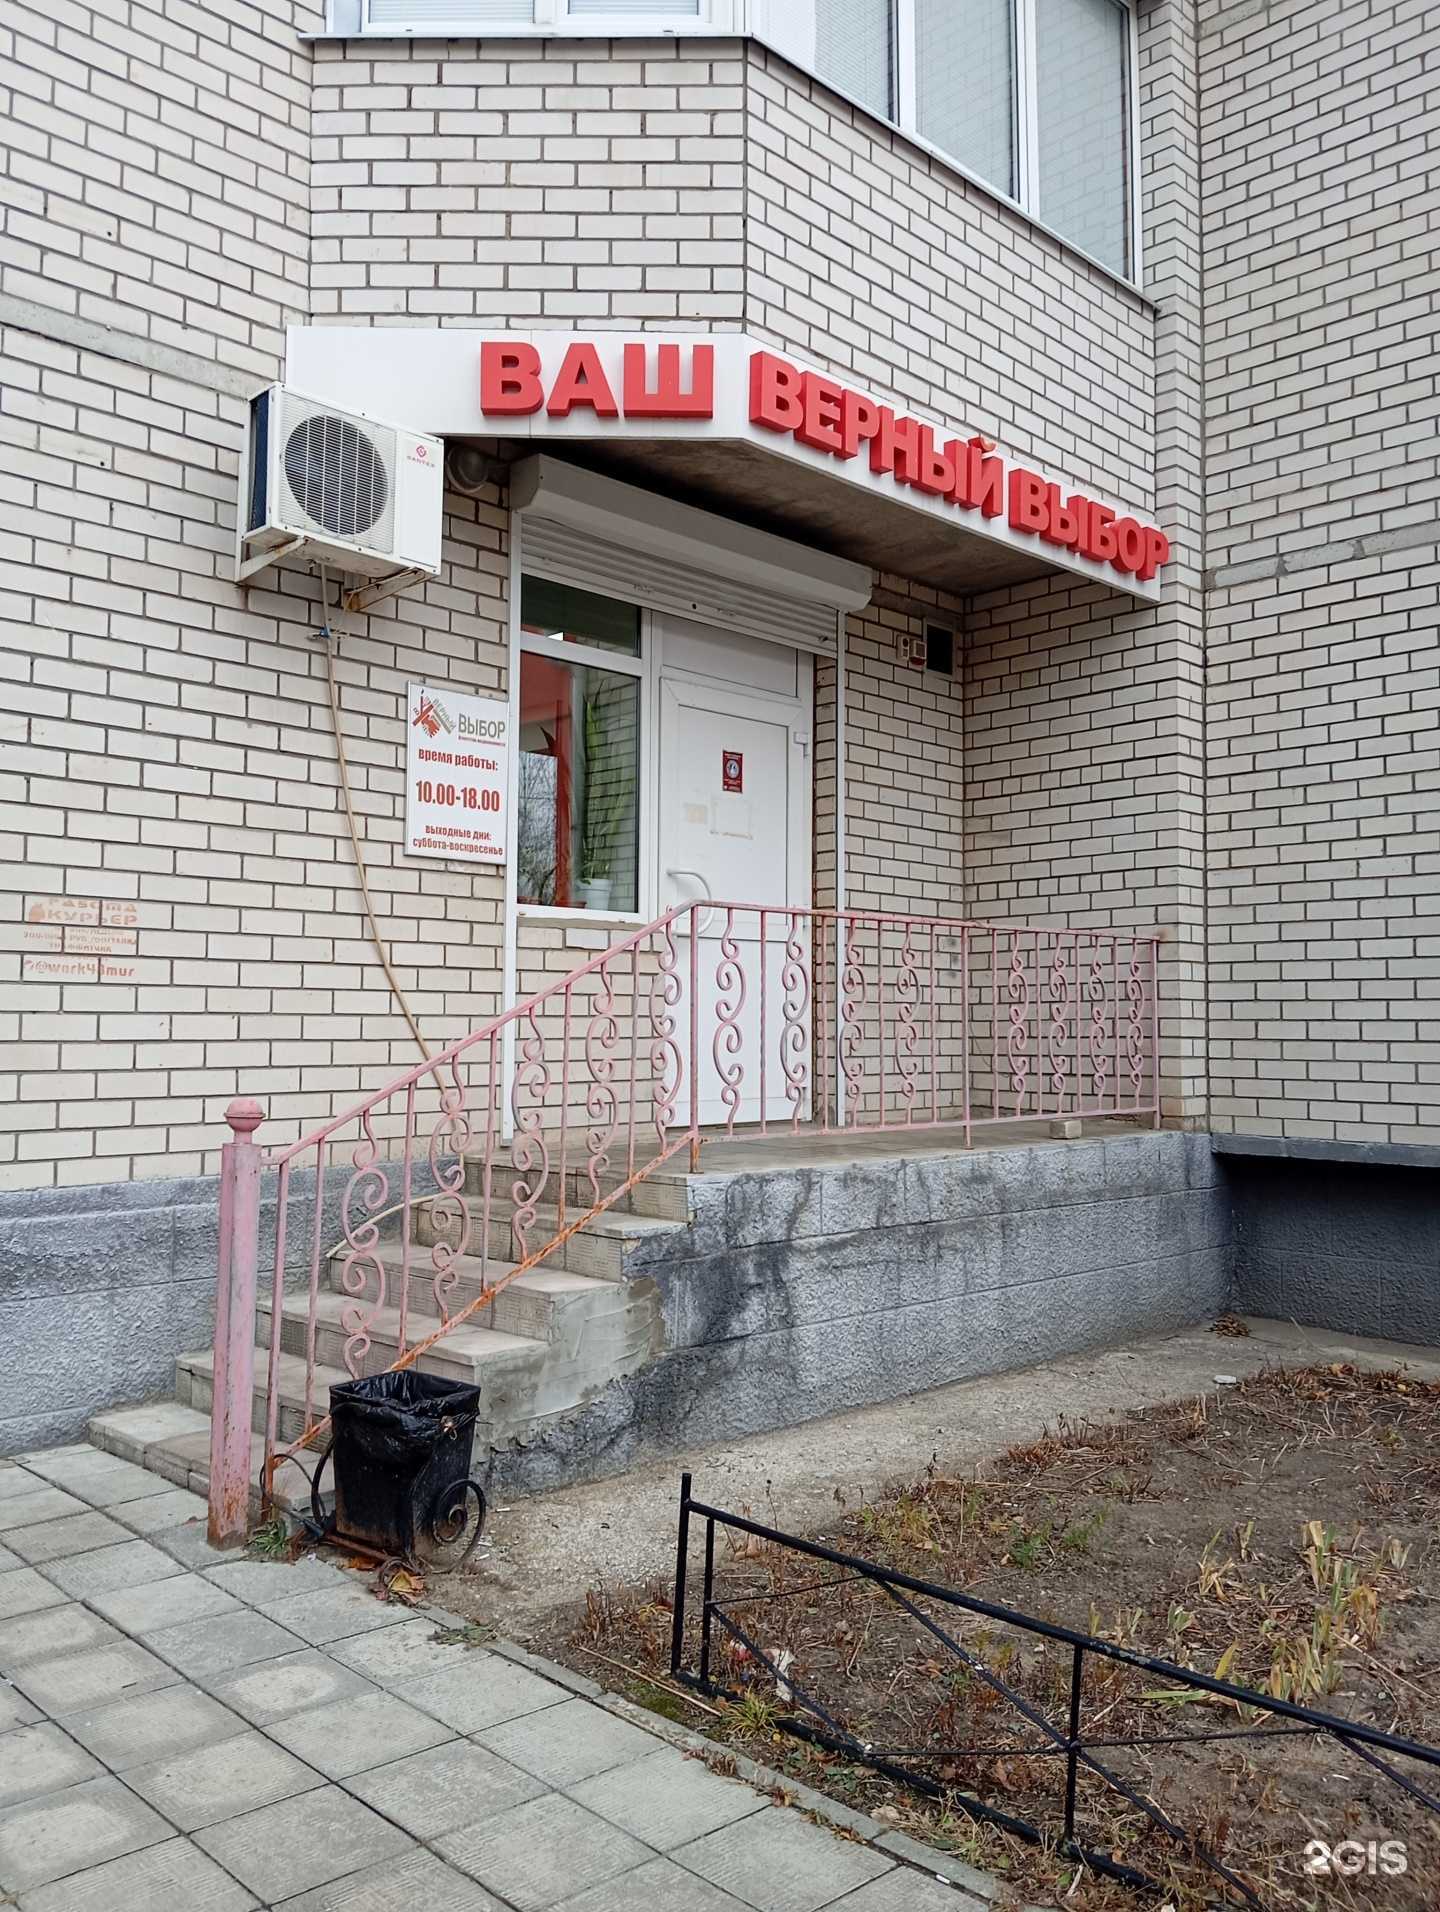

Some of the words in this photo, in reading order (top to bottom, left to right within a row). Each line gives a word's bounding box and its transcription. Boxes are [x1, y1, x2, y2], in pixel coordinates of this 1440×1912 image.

[481, 341, 714, 419] ВАШ
[749, 350, 1005, 519] ВЕРНЫЙ
[1008, 467, 1169, 581] ВЫБОР
[458, 713, 506, 739] ВЫБОР
[418, 748, 453, 765] время
[455, 754, 499, 771] работы:
[416, 780, 500, 812] 10.00-18.00
[425, 825, 471, 838] выходные
